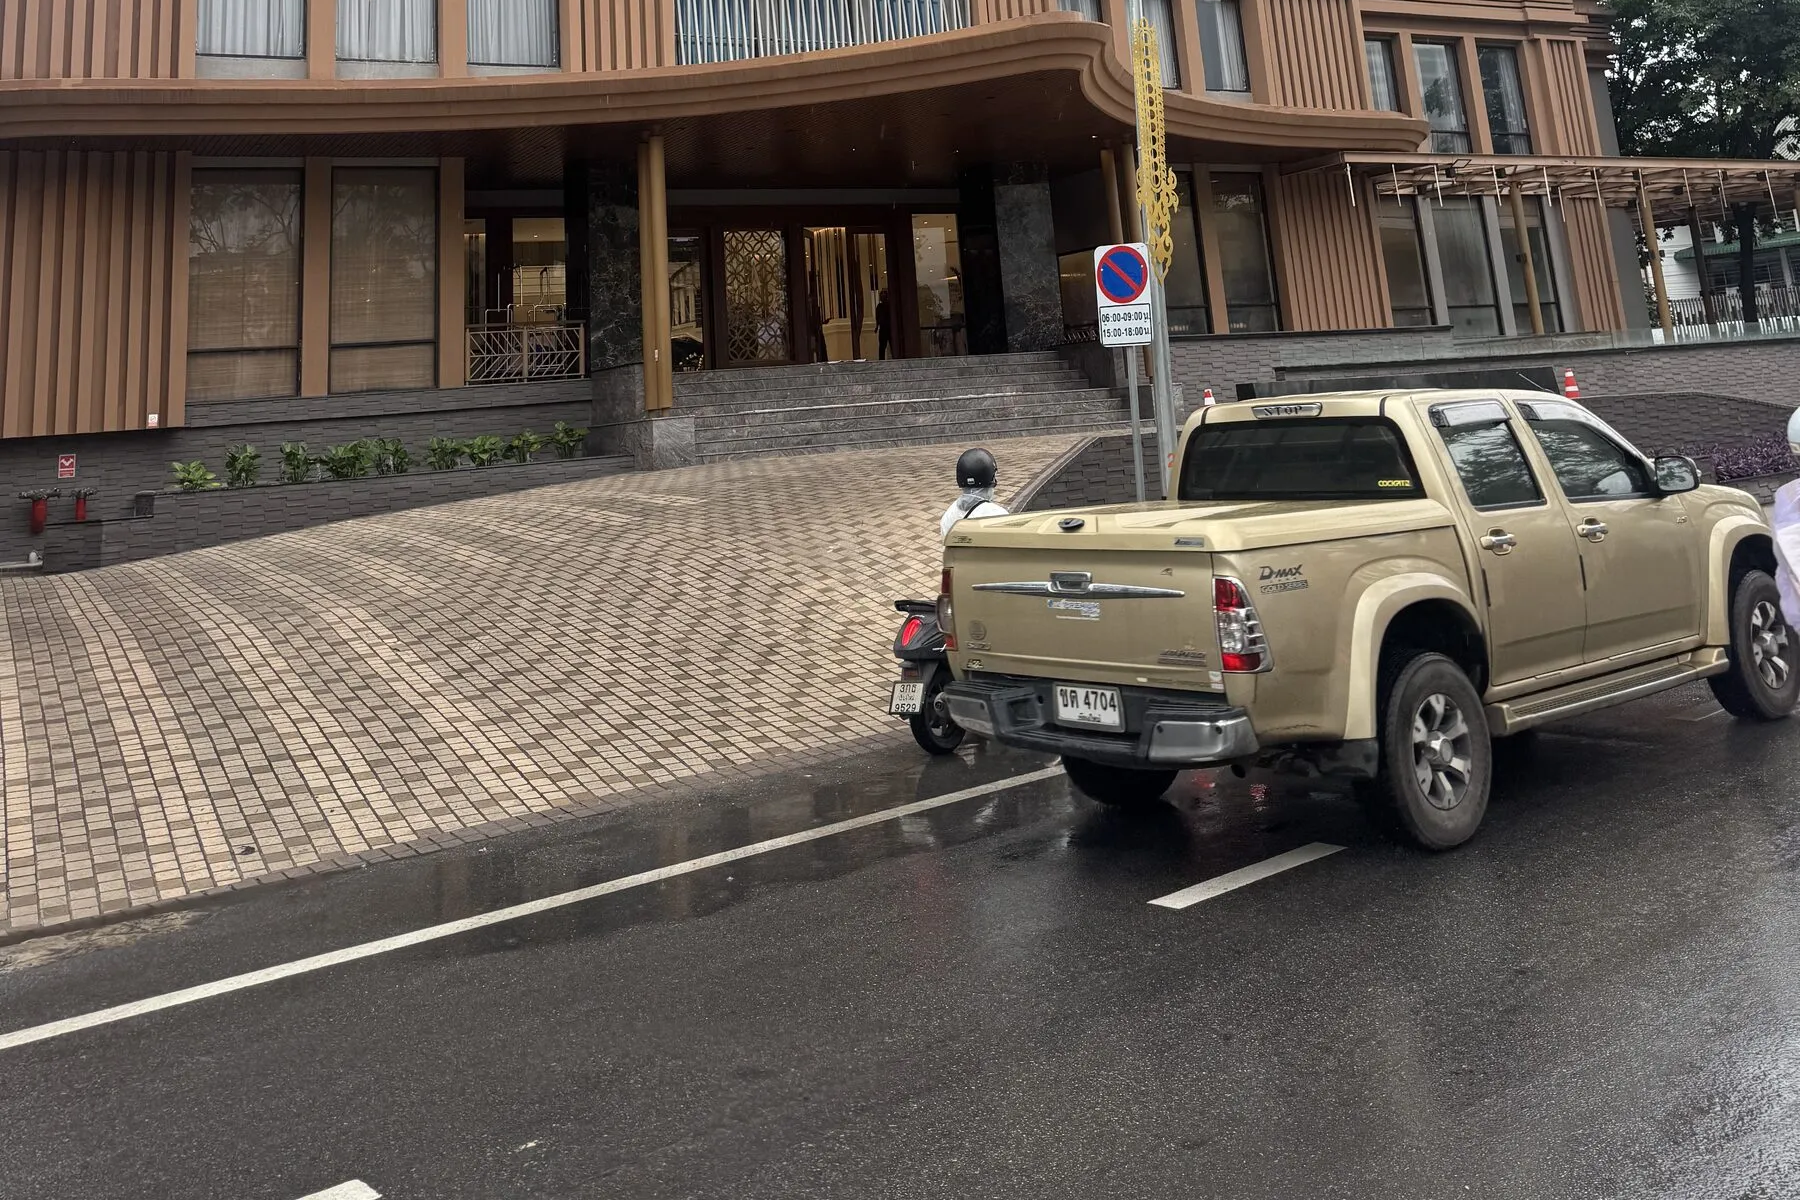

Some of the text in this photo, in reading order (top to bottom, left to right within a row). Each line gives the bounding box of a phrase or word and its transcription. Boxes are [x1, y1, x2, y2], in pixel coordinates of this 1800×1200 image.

[1264, 404, 1303, 417] STOP
[1083, 689, 1117, 712] 4704
[894, 703, 916, 712] 9529
